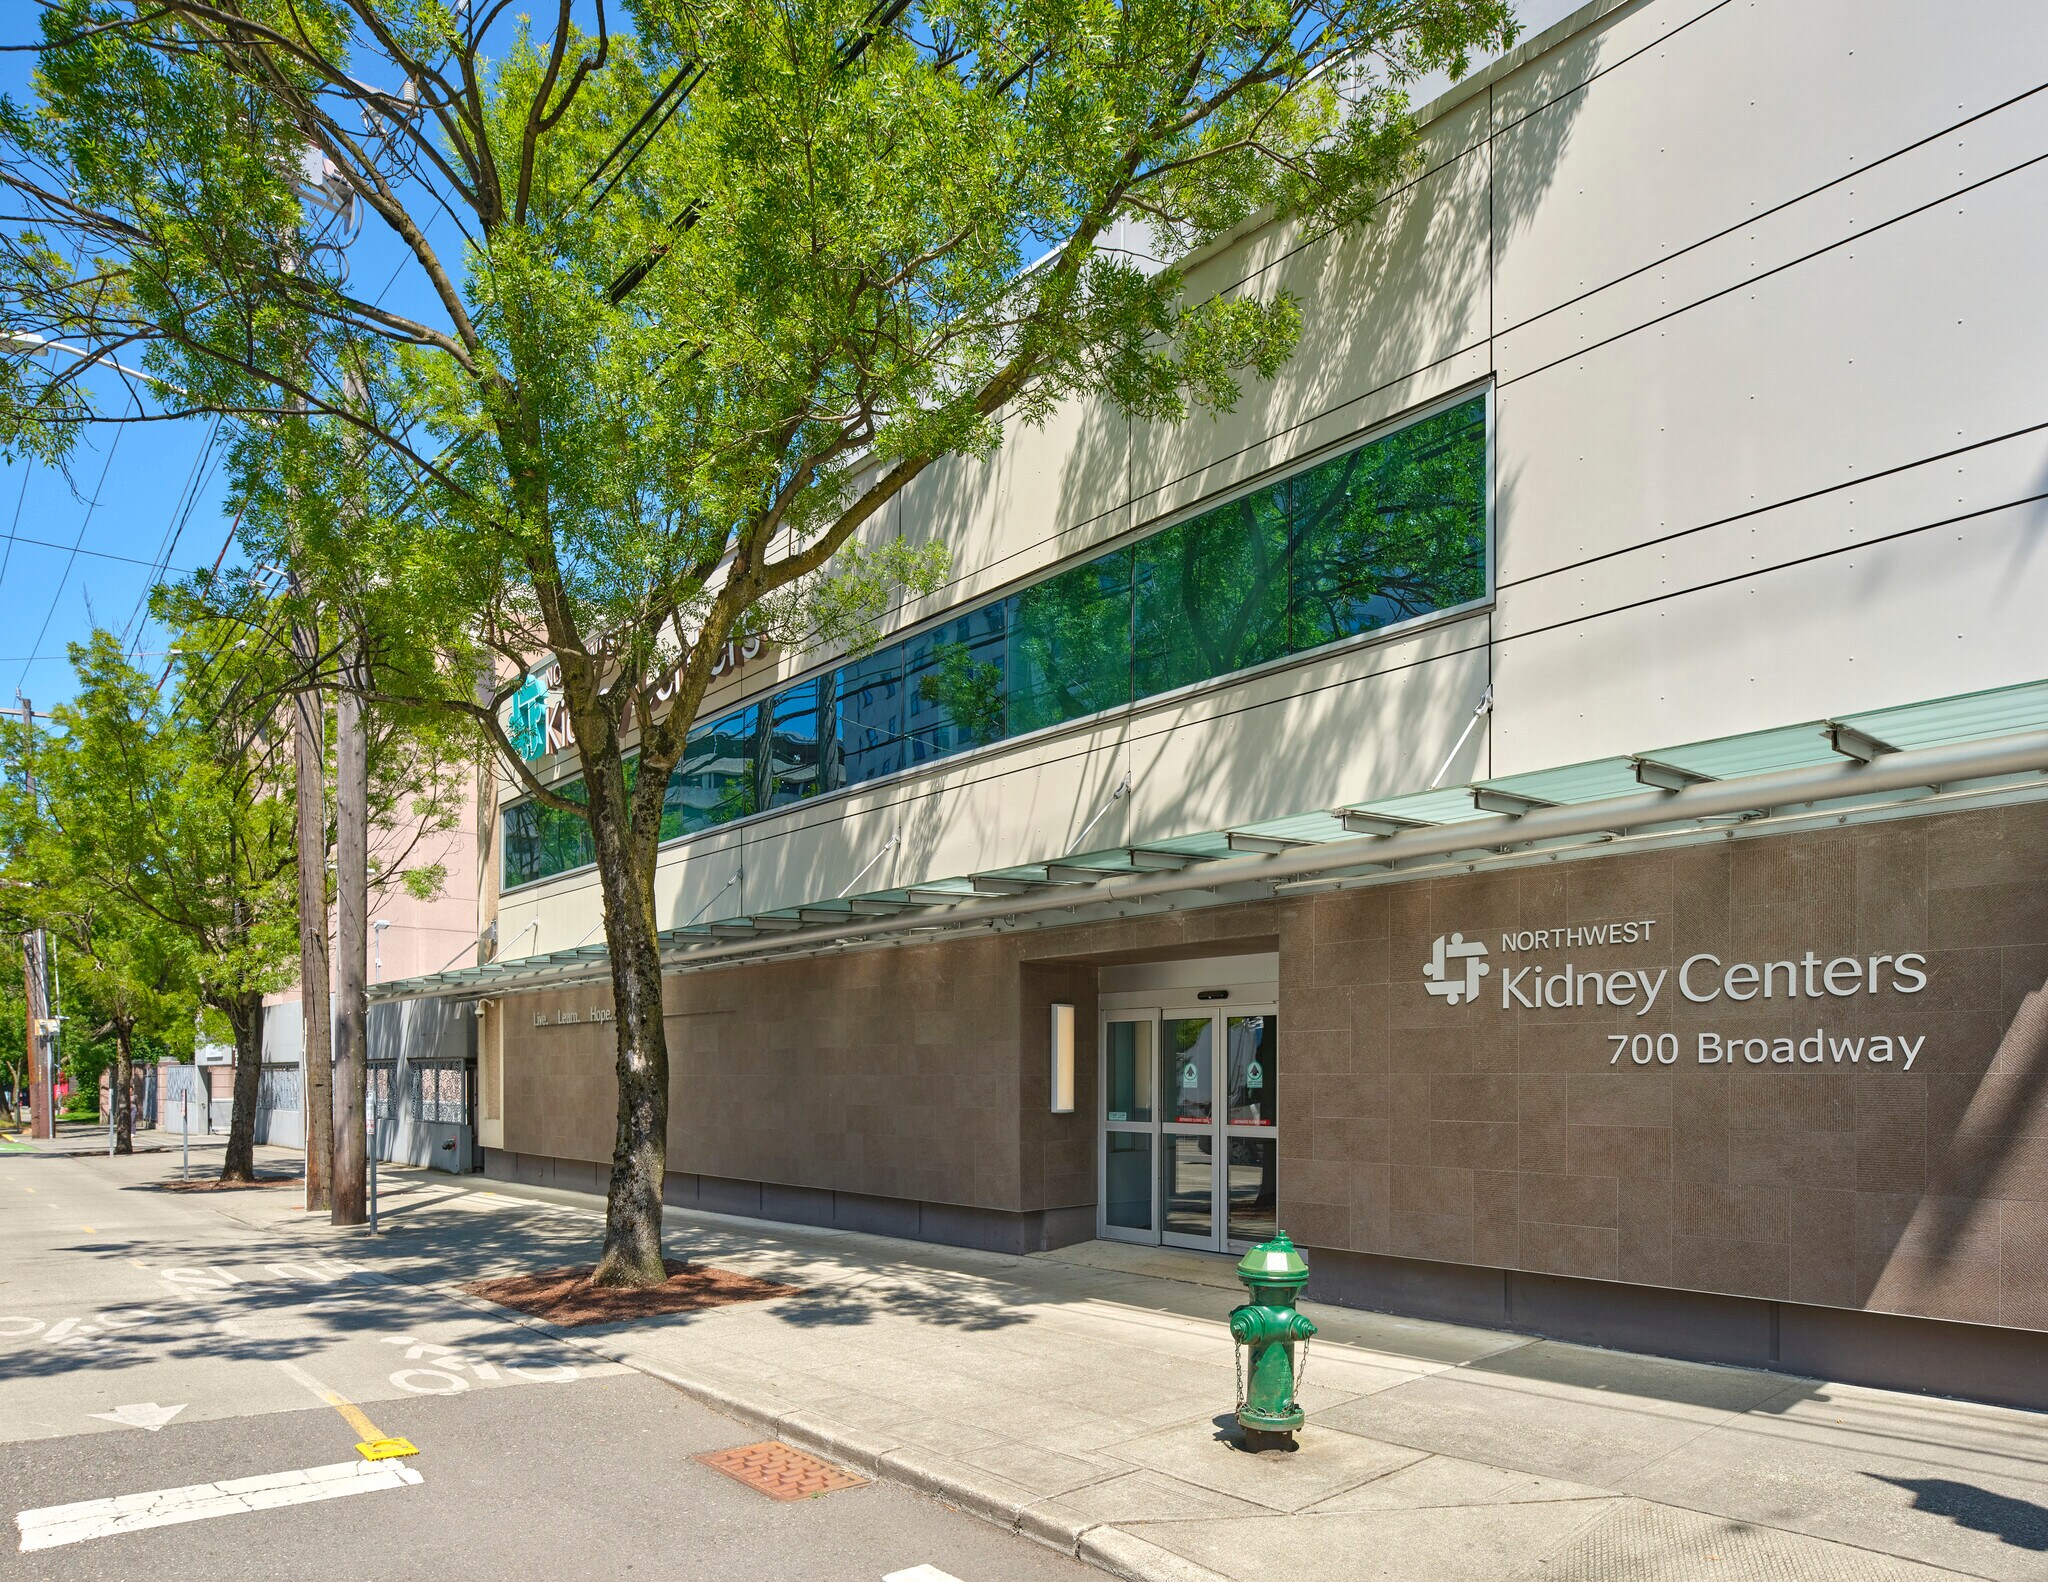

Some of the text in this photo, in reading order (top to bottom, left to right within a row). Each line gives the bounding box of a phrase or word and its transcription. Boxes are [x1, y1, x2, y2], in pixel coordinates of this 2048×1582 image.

[1502, 920, 1656, 952] NORTHWEST
[1502, 951, 1927, 1016] Kidney Centers
[590, 1006, 612, 1024] Hope.
[1607, 1028, 1926, 1071] 700 Broadway
